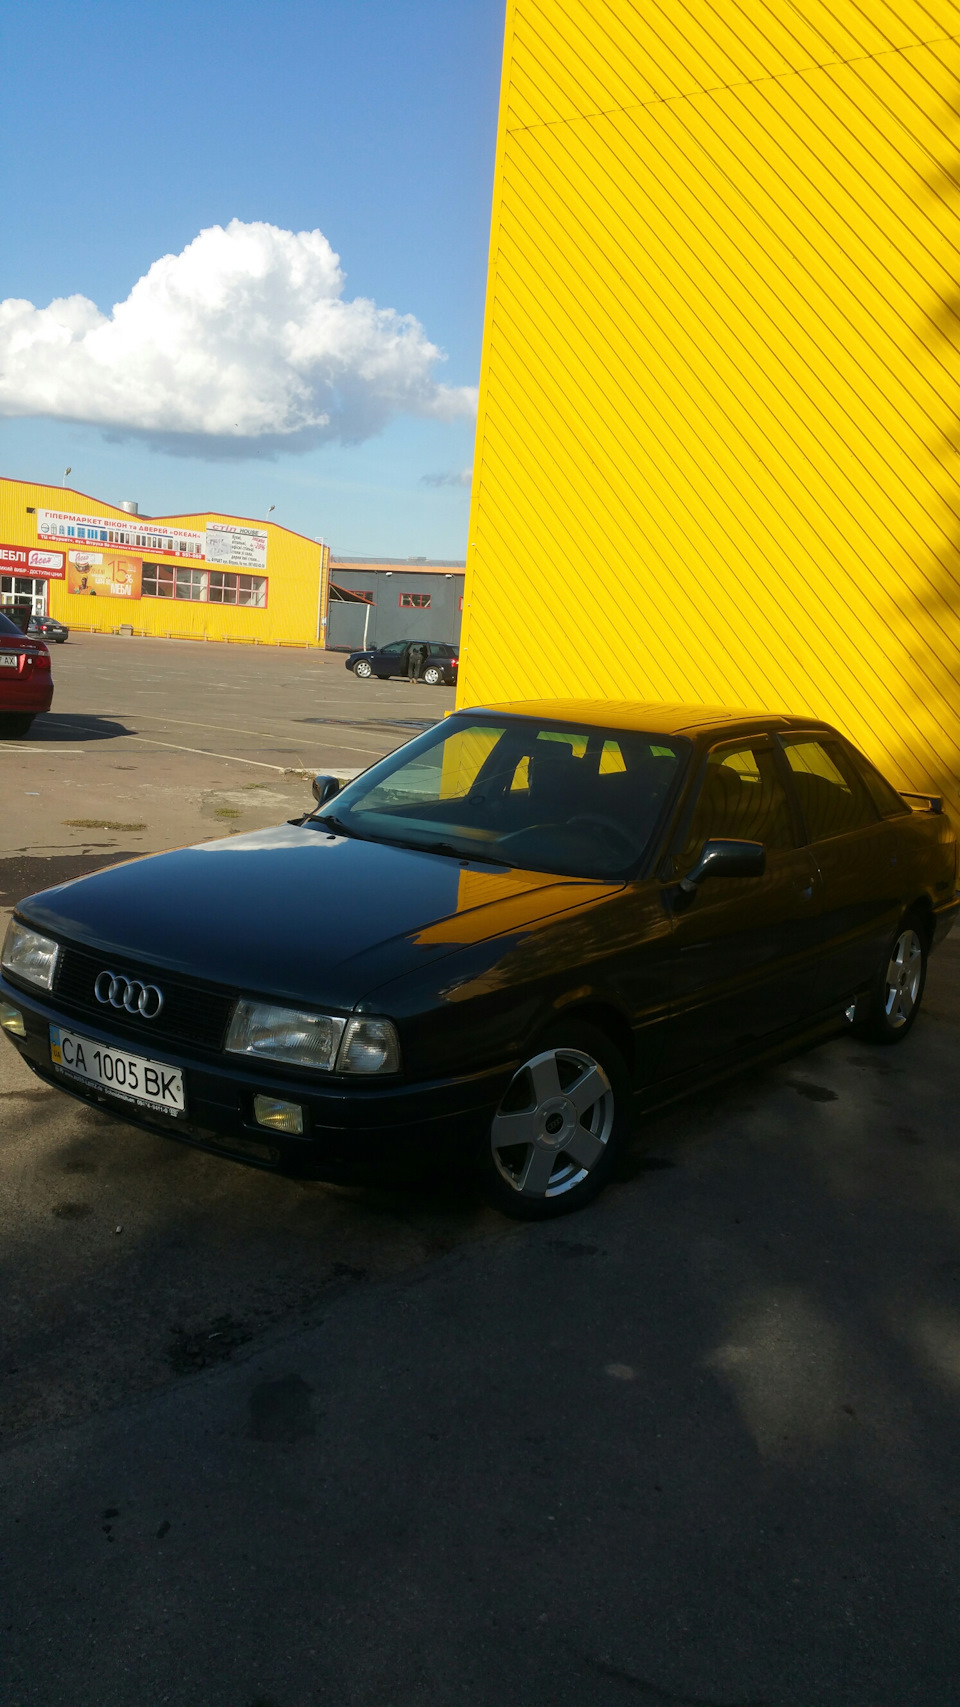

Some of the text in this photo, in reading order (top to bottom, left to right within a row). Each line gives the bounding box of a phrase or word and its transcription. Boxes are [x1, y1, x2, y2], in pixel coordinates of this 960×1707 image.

[45, 512, 102, 525] ГІПЕРМАРКЕТ
[104, 520, 127, 529] ВІКОН
[138, 526, 168, 534] ДВЕРЕЙ
[62, 1037, 87, 1072] CA
[93, 1050, 138, 1090] 1005
[144, 1066, 178, 1103] BK
